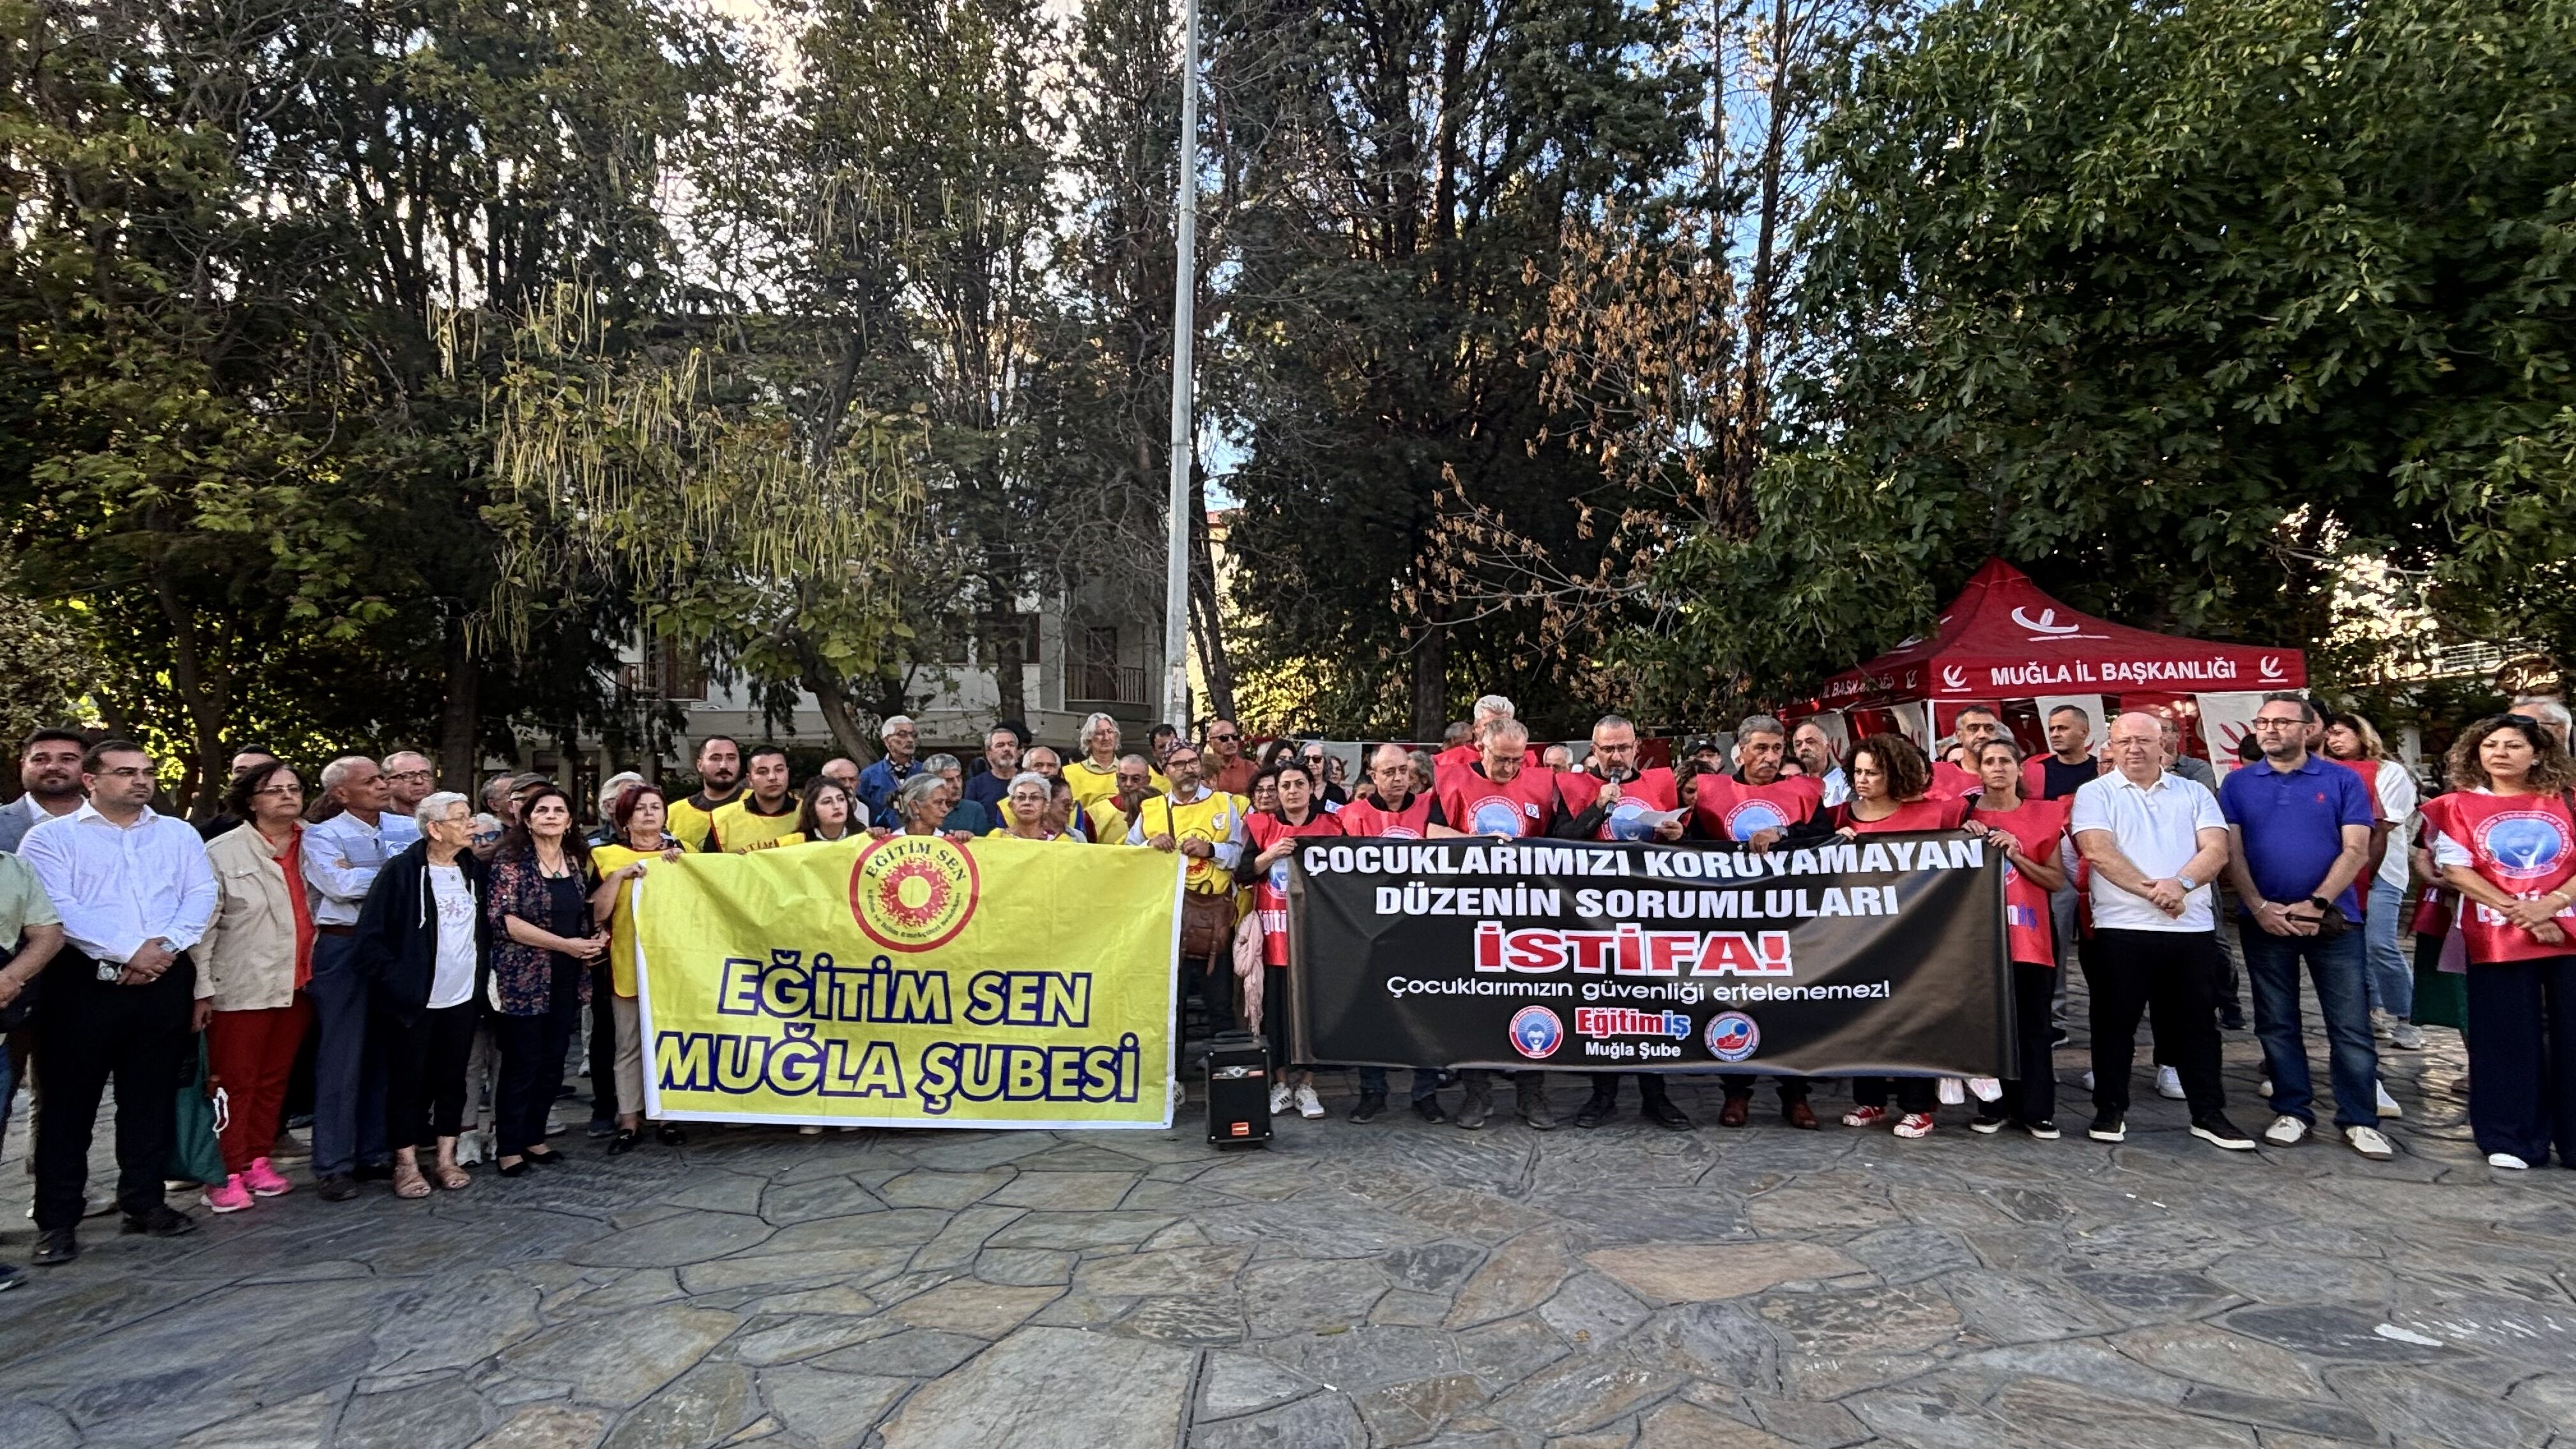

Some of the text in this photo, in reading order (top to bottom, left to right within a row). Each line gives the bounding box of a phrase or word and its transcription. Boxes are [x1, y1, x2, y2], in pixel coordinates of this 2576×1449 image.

[1991, 657, 2236, 686] MUĞLA İL BAŞKANLIĞI
[865, 840, 967, 881] EĞİTİM SEN
[1303, 838, 1984, 878] ÇOCUKLARIMIZI KORUYAMAYAN
[1376, 882, 1899, 919] DÜZENİN SORUMLULARI
[1474, 921, 1793, 977] İSTİFA!
[717, 947, 1093, 1029] EĞİTİM SEN
[1387, 976, 1890, 1004] Çocuklarımızın güvenliği ertelenemez!
[1574, 1006, 1692, 1040] Eğitimiş
[655, 1022, 1141, 1115] MUĞLA ŞUBESİ
[1585, 1041, 1682, 1059] Muğla Şube
